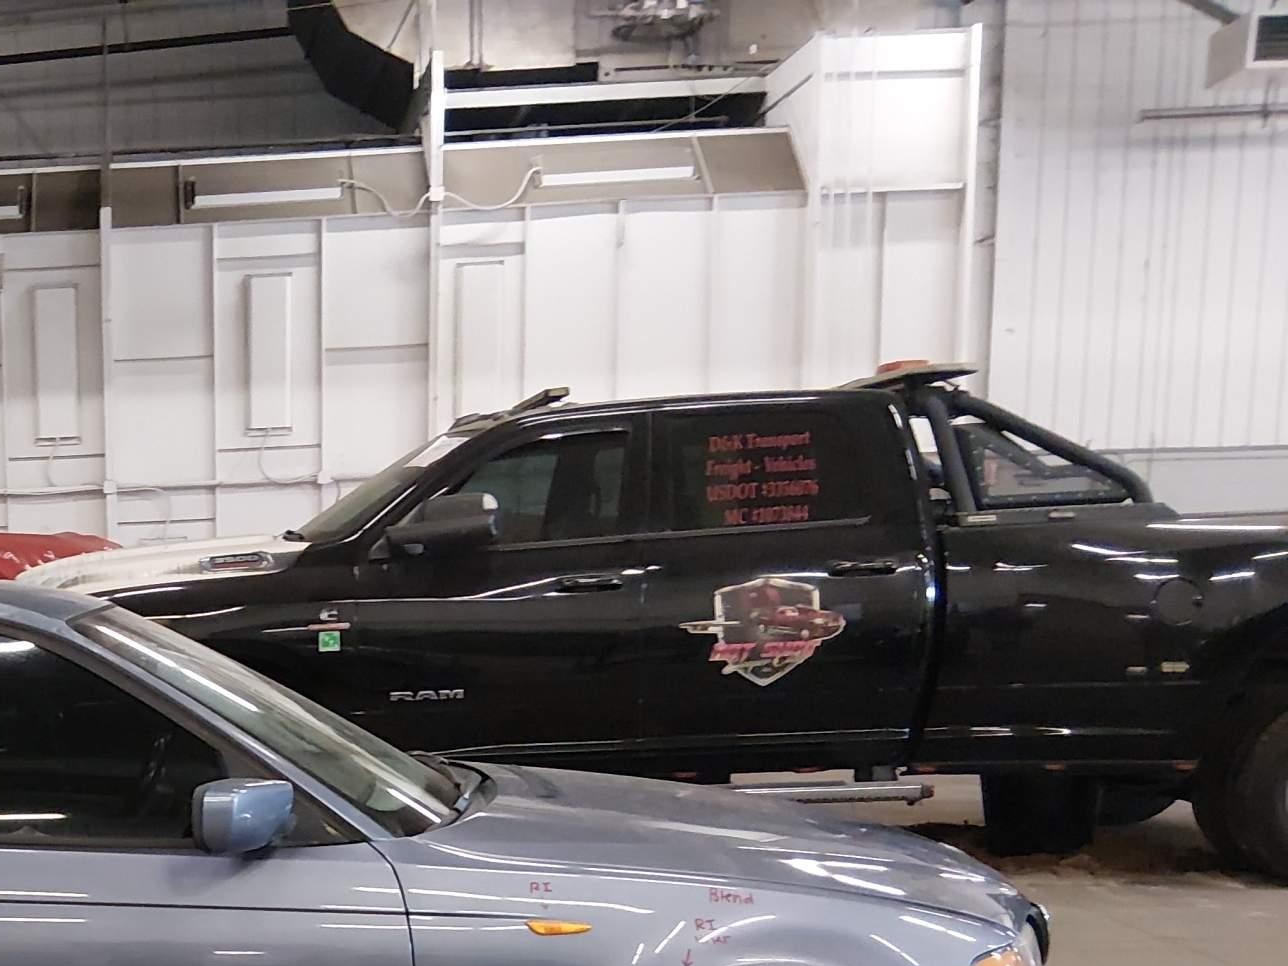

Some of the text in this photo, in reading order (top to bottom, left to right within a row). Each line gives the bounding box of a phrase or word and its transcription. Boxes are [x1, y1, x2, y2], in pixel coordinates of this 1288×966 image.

[706, 482, 759, 501] USDOT
[389, 689, 465, 701] RAM
[708, 887, 754, 905] Blend
